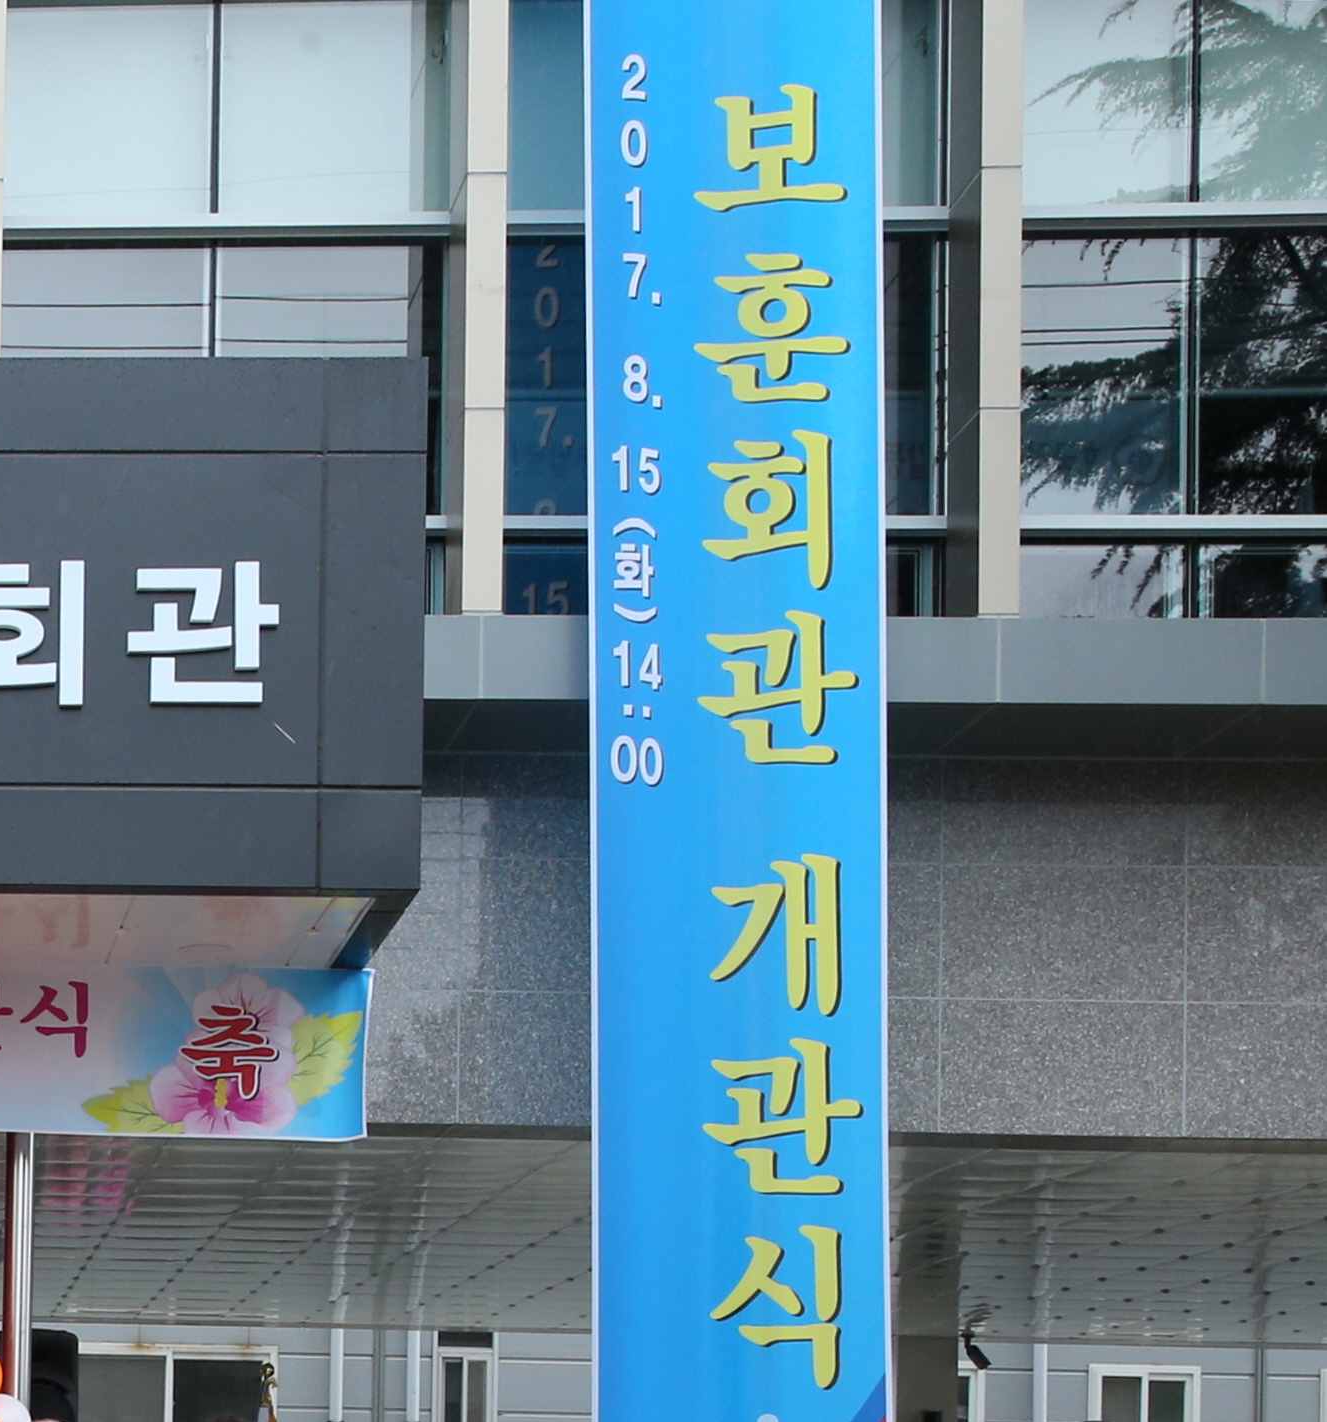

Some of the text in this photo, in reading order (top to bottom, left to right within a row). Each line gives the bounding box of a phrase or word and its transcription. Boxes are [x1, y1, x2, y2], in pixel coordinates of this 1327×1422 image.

[620, 54, 663, 306] 2017.
[623, 355, 663, 409] 8.
[694, 84, 864, 1389] 보훈회관 개관식
[180, 1004, 280, 1099] 축
